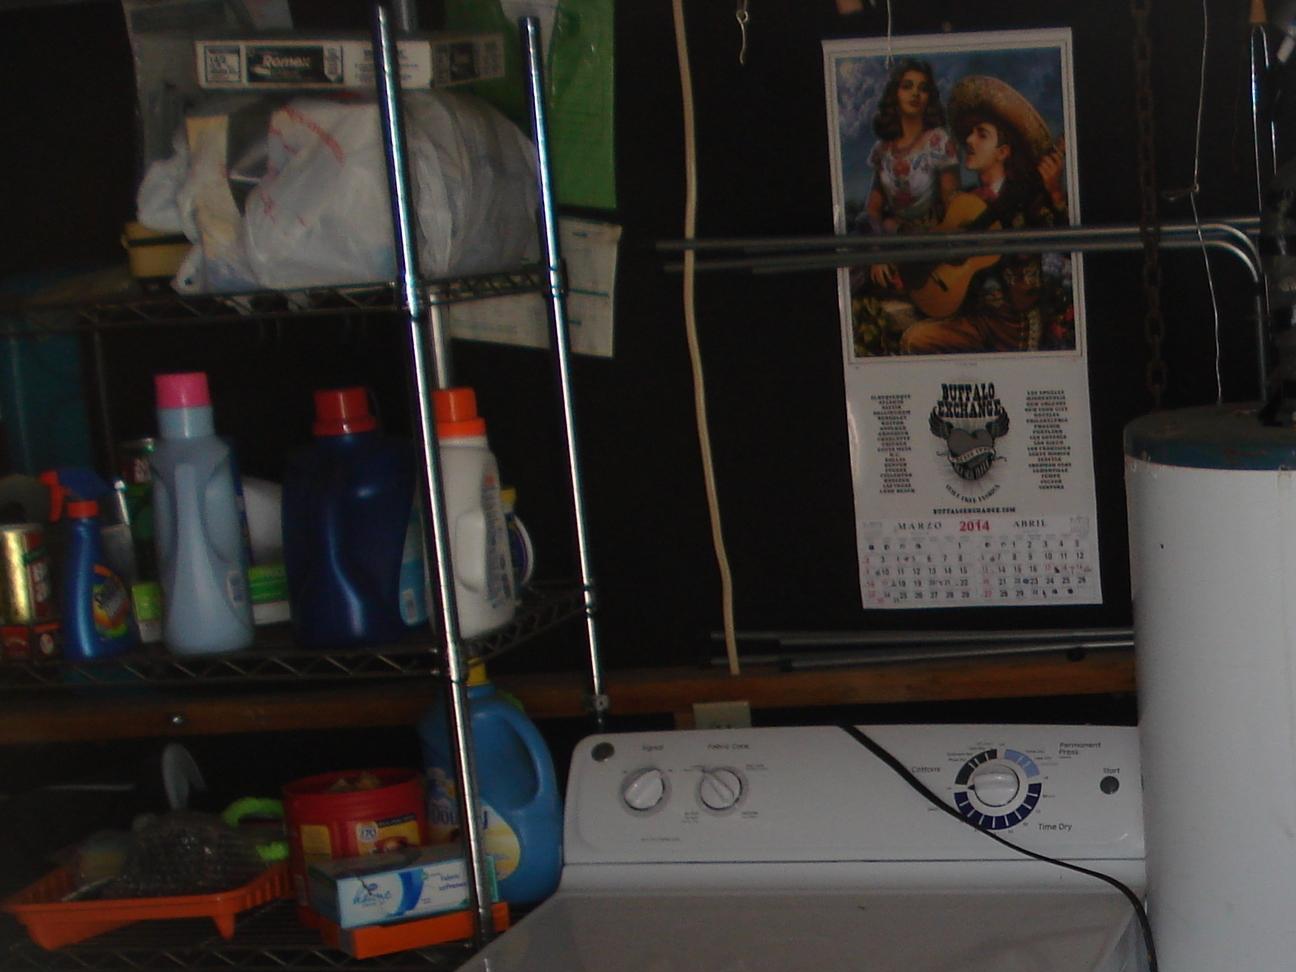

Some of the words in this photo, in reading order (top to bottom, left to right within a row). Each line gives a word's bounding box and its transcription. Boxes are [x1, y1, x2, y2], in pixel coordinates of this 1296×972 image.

[941, 383, 995, 401] BUFFALO
[938, 399, 1001, 418] EXCHANGE
[959, 520, 991, 532] 2014
[1039, 823, 1056, 831] Time
[1059, 823, 1072, 831] Dry
